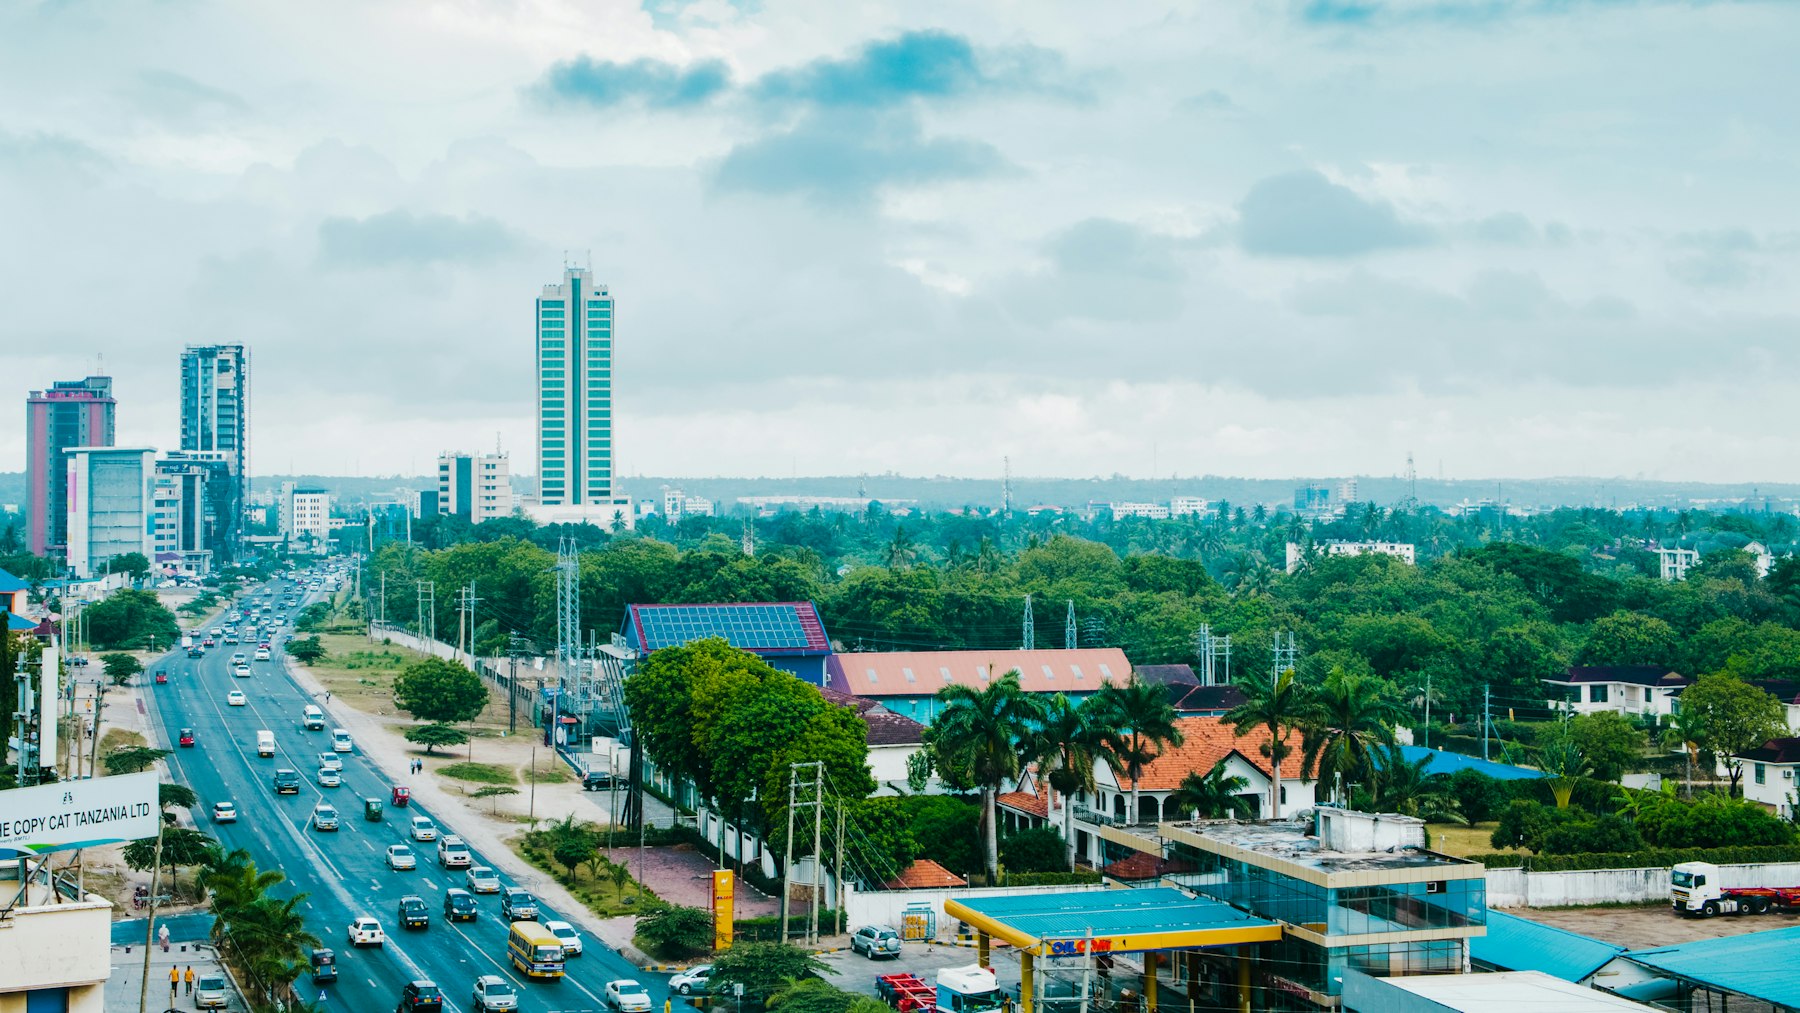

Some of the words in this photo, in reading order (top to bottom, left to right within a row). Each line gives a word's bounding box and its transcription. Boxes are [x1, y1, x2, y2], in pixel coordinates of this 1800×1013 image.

[14, 817, 46, 835] COPY
[49, 813, 71, 830] CAT
[74, 805, 128, 826] TANZANIA
[131, 802, 150, 818] LTD
